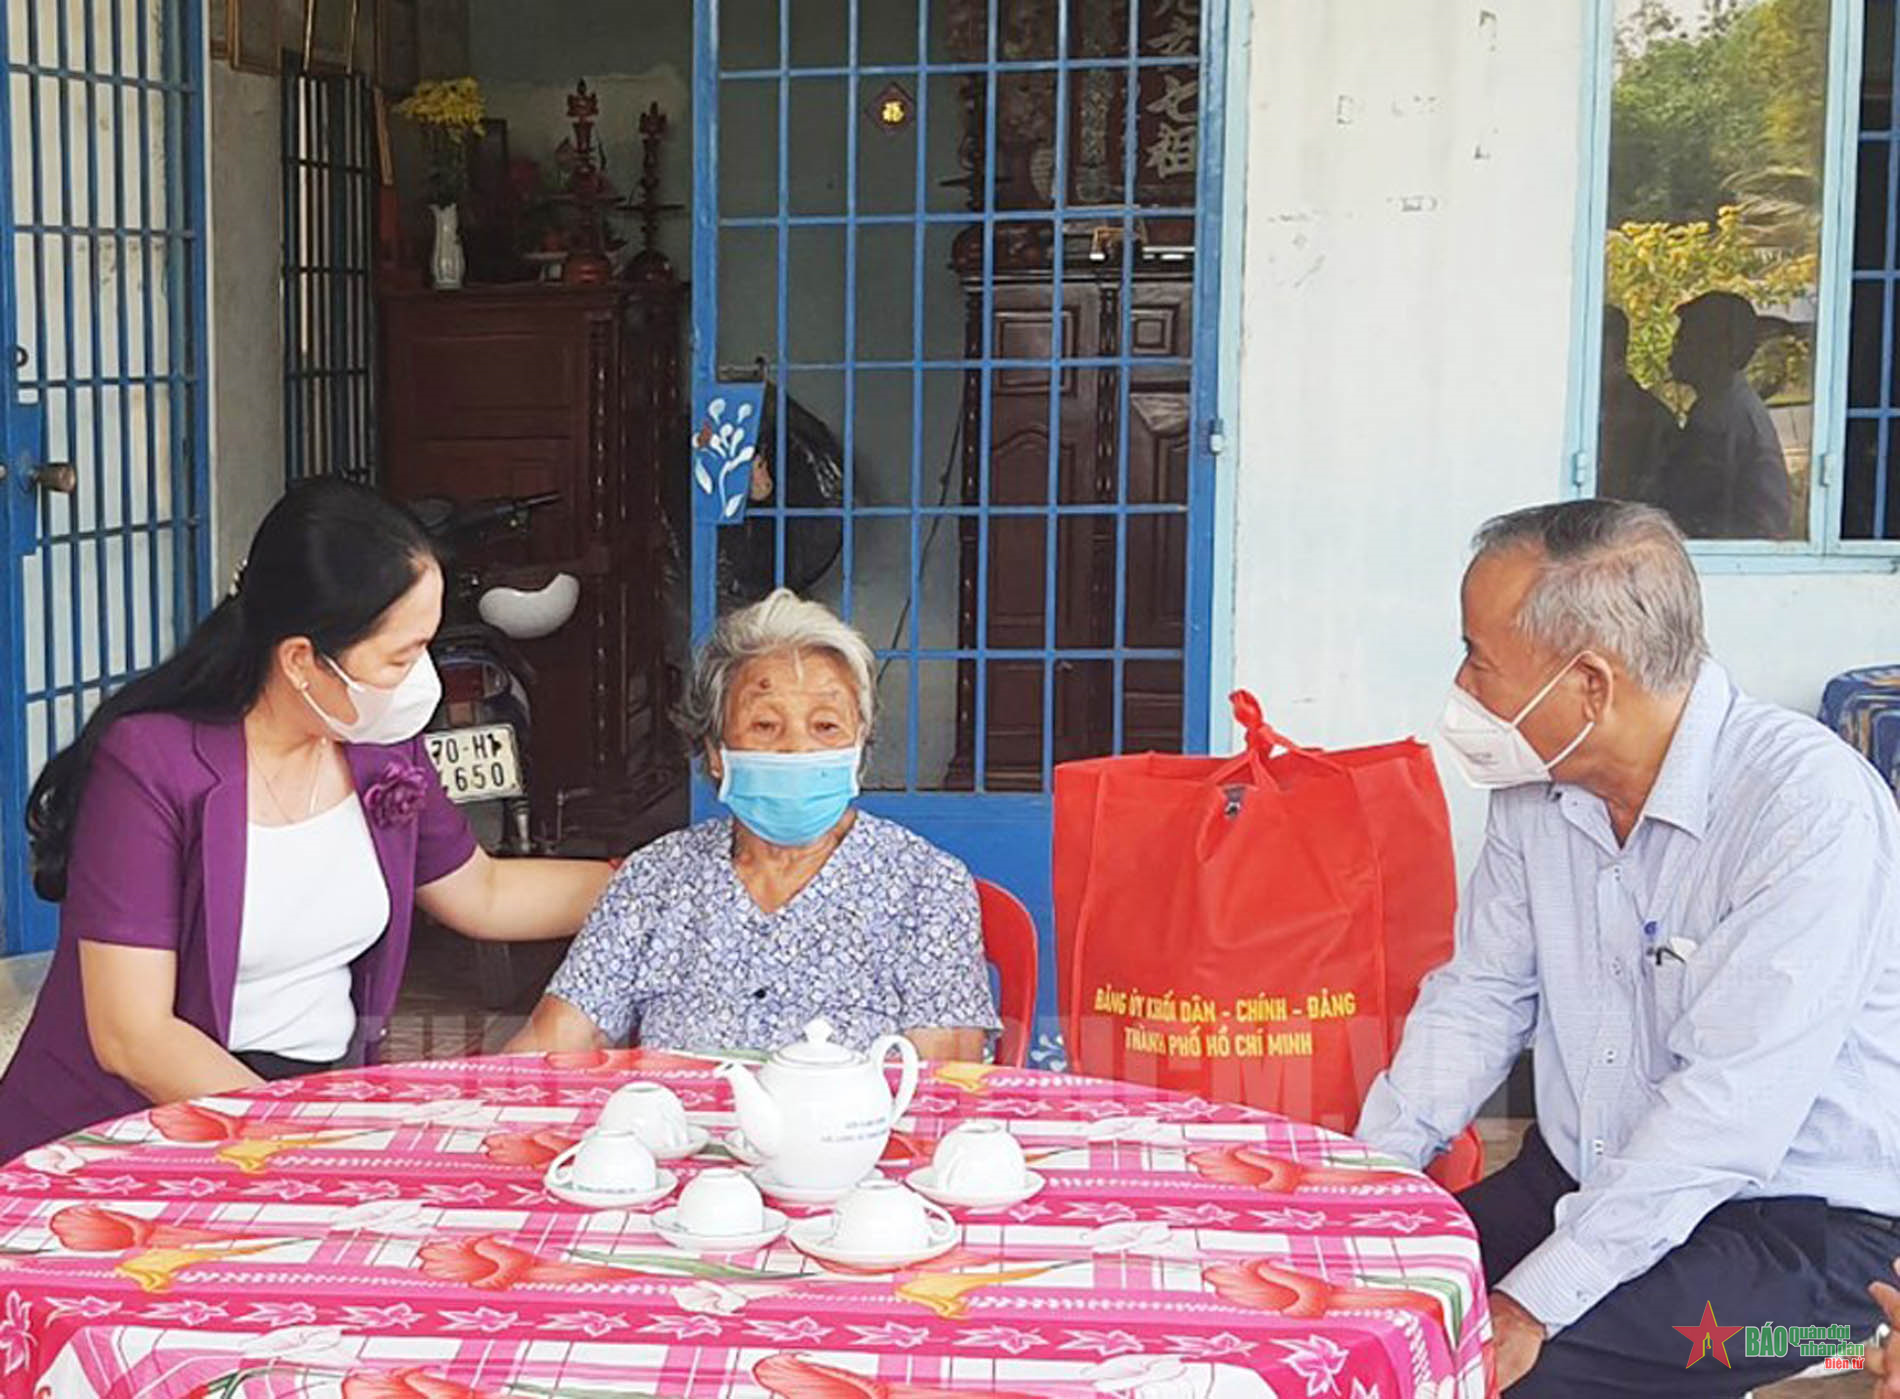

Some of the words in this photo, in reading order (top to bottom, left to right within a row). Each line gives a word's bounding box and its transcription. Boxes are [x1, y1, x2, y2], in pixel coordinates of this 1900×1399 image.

[455, 762, 504, 791] 650
[1180, 994, 1217, 1023] DÂN
[1236, 992, 1288, 1023] CHÍNH
[1235, 1028, 1264, 1057] CHÍ
[1267, 1032, 1312, 1056] MINH
